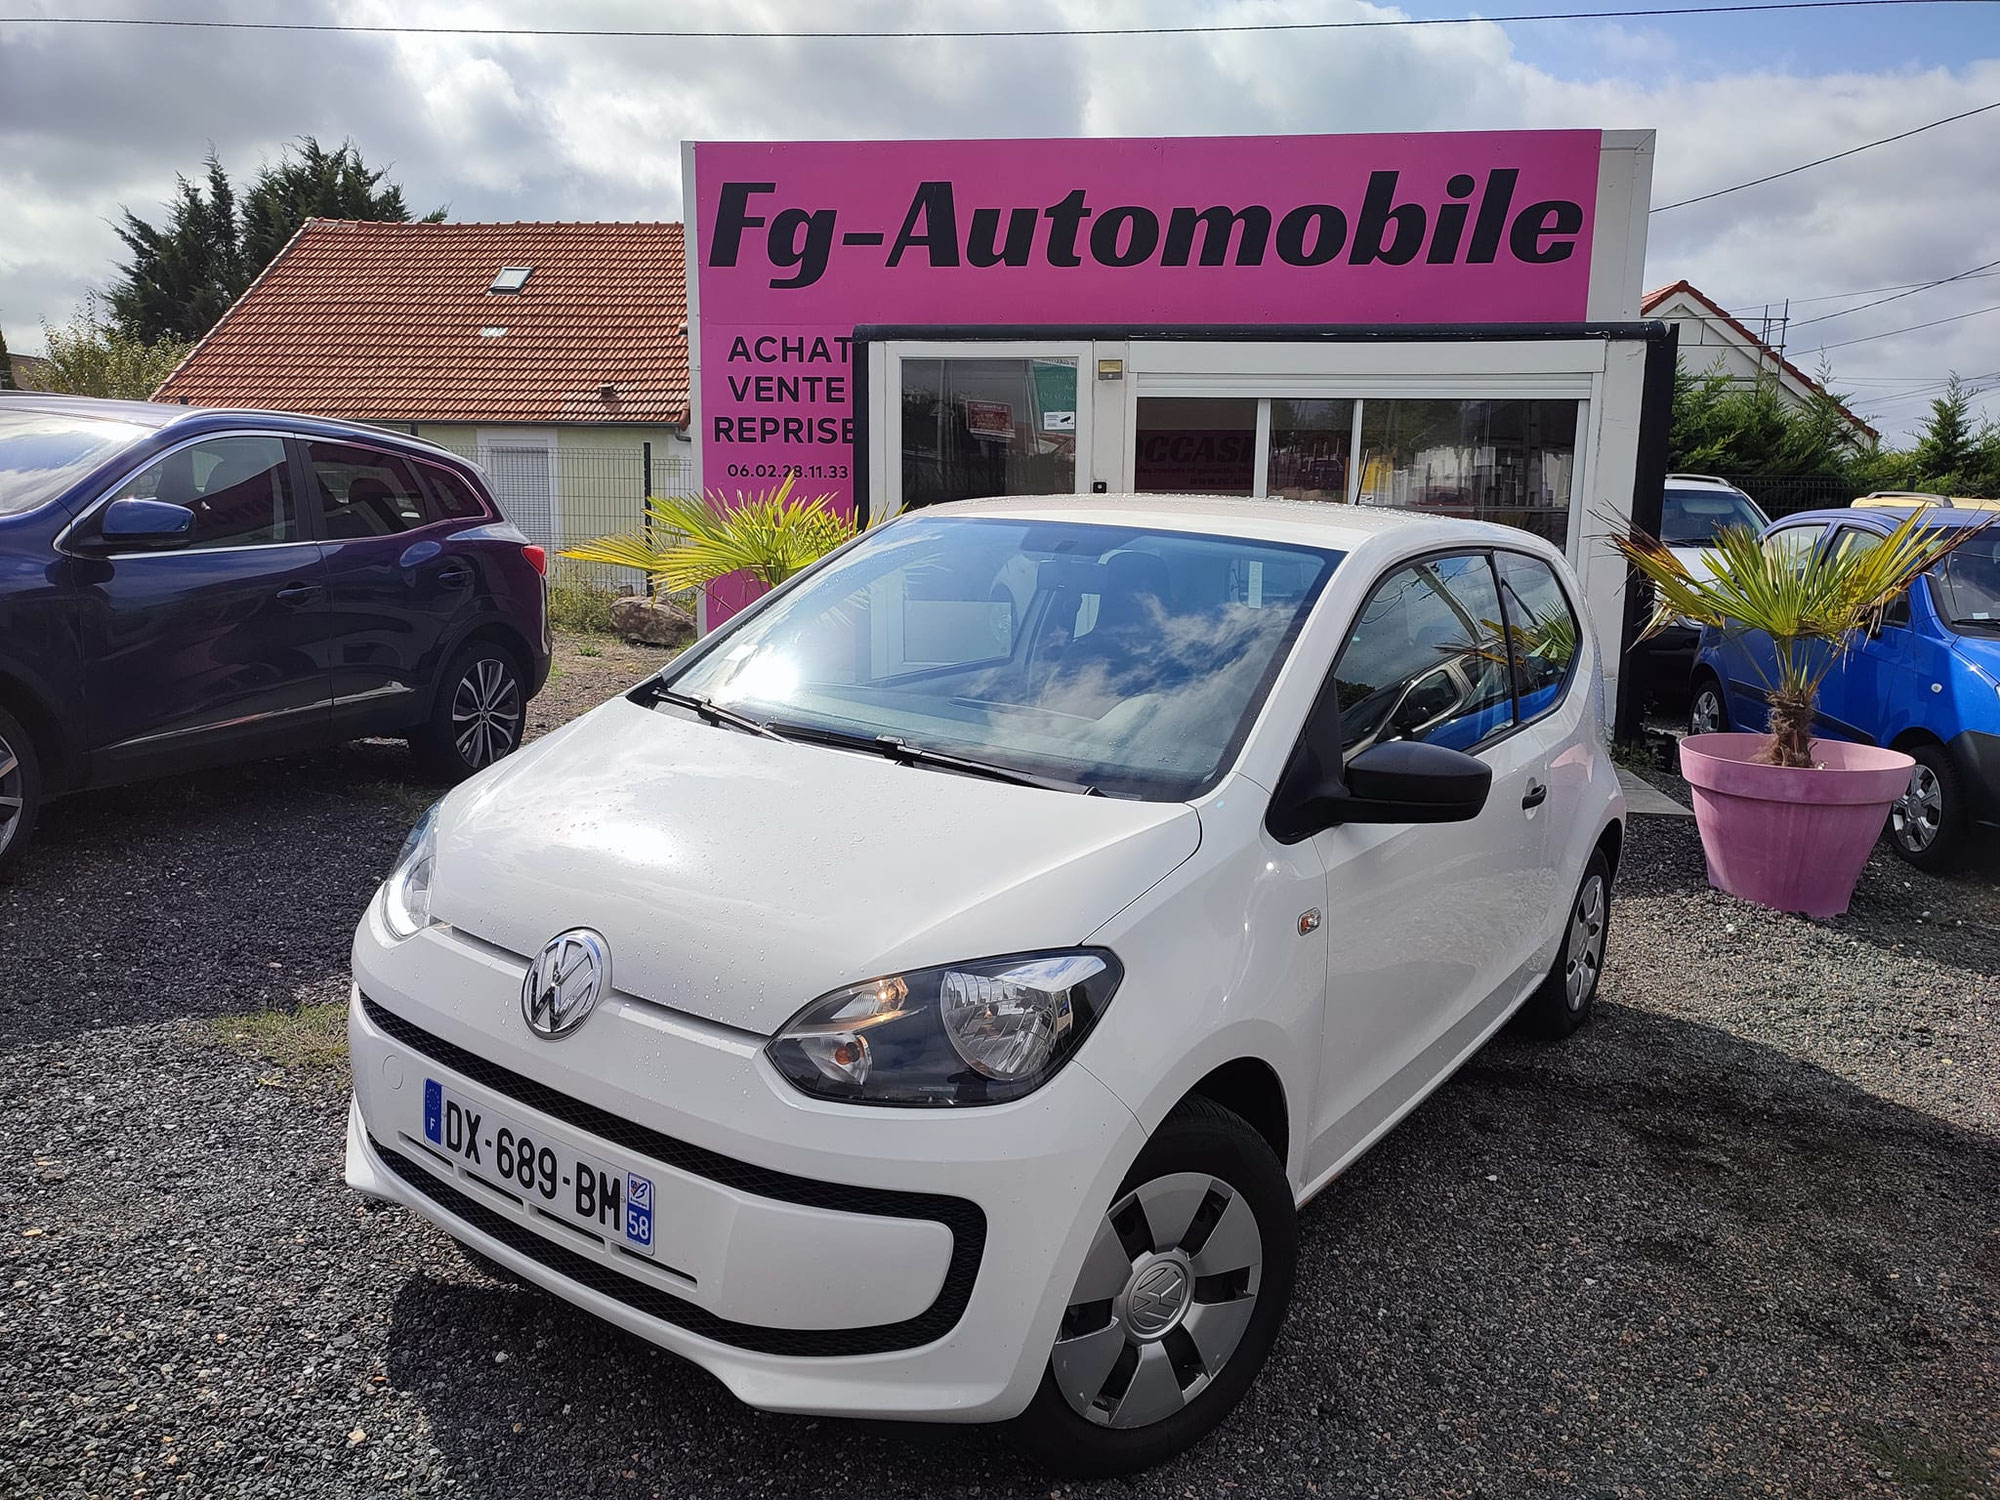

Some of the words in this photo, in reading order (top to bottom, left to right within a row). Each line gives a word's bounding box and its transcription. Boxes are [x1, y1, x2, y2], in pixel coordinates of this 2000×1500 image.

[708, 168, 1584, 289] Fg-Automobile
[727, 336, 853, 363] ACHAT
[727, 376, 846, 403] VENTE
[714, 416, 854, 444] REPRISE
[727, 464, 849, 479] 06.02.28.11.33
[429, 1117, 436, 1131] F
[446, 1099, 621, 1232] DX-689-BM
[628, 1211, 649, 1240] 58
